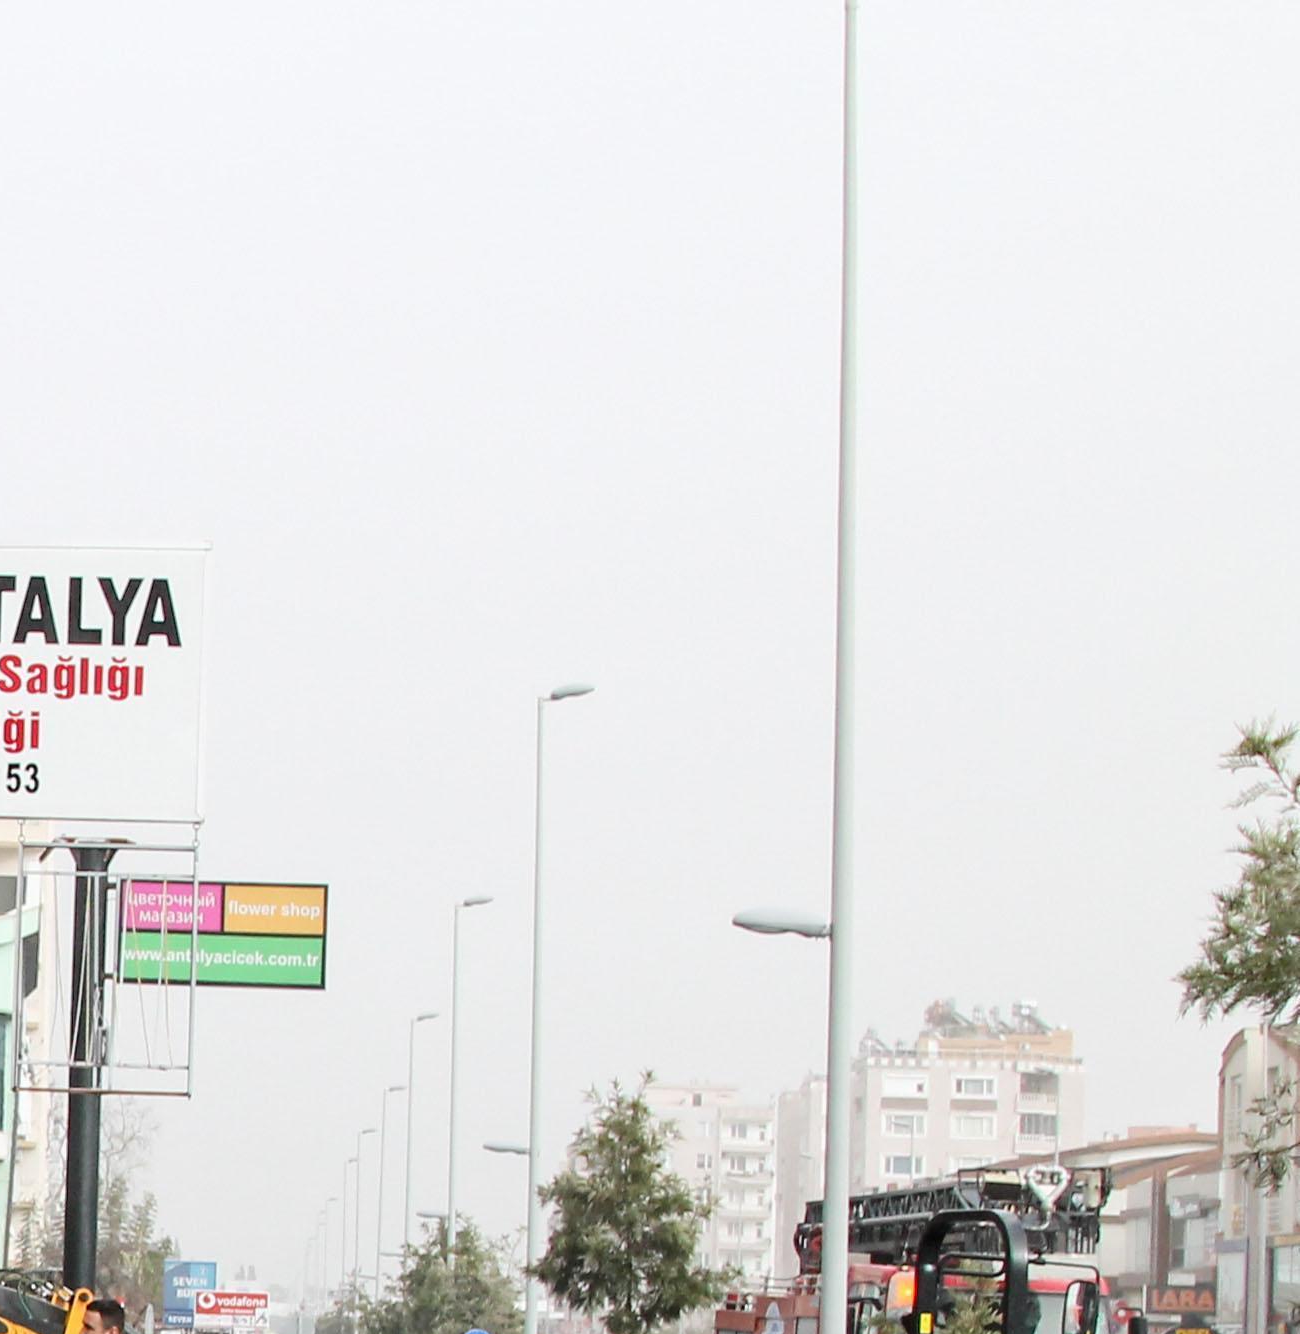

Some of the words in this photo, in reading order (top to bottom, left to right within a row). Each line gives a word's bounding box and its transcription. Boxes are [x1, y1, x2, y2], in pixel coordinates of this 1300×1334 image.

[6, 763, 41, 793] 53
[228, 901, 277, 917] flower
[281, 904, 321, 919] shop
[216, 1295, 267, 1308] vodafone
